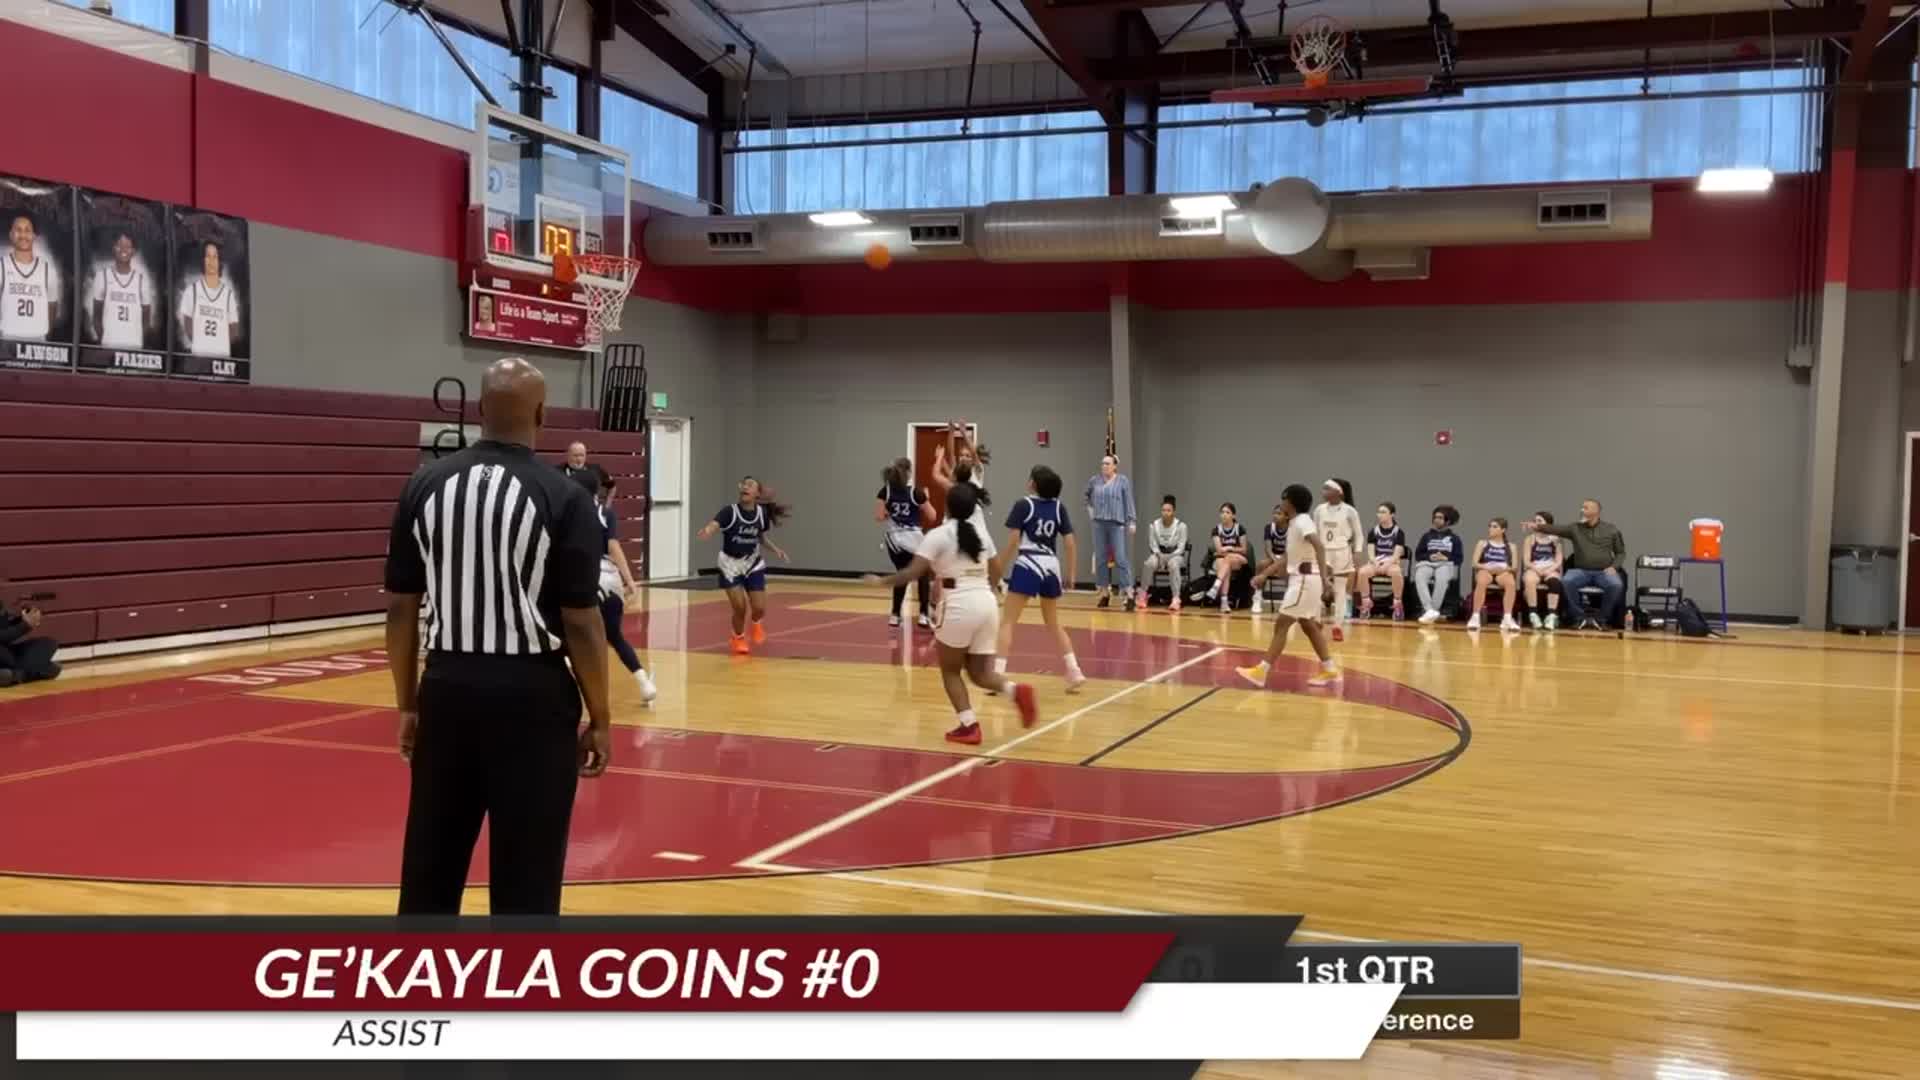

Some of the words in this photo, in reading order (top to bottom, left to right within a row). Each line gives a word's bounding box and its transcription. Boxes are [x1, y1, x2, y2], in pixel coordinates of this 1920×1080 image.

[17, 298, 34, 317] 20
[117, 305, 129, 321] 21
[526, 306, 542, 320] Team
[204, 319, 217, 337] 22
[16, 343, 69, 363] LAWSON
[114, 351, 163, 370] FRAZIER
[212, 360, 236, 375] CLAY
[891, 501, 910, 517] 32
[1034, 519, 1055, 538] 10
